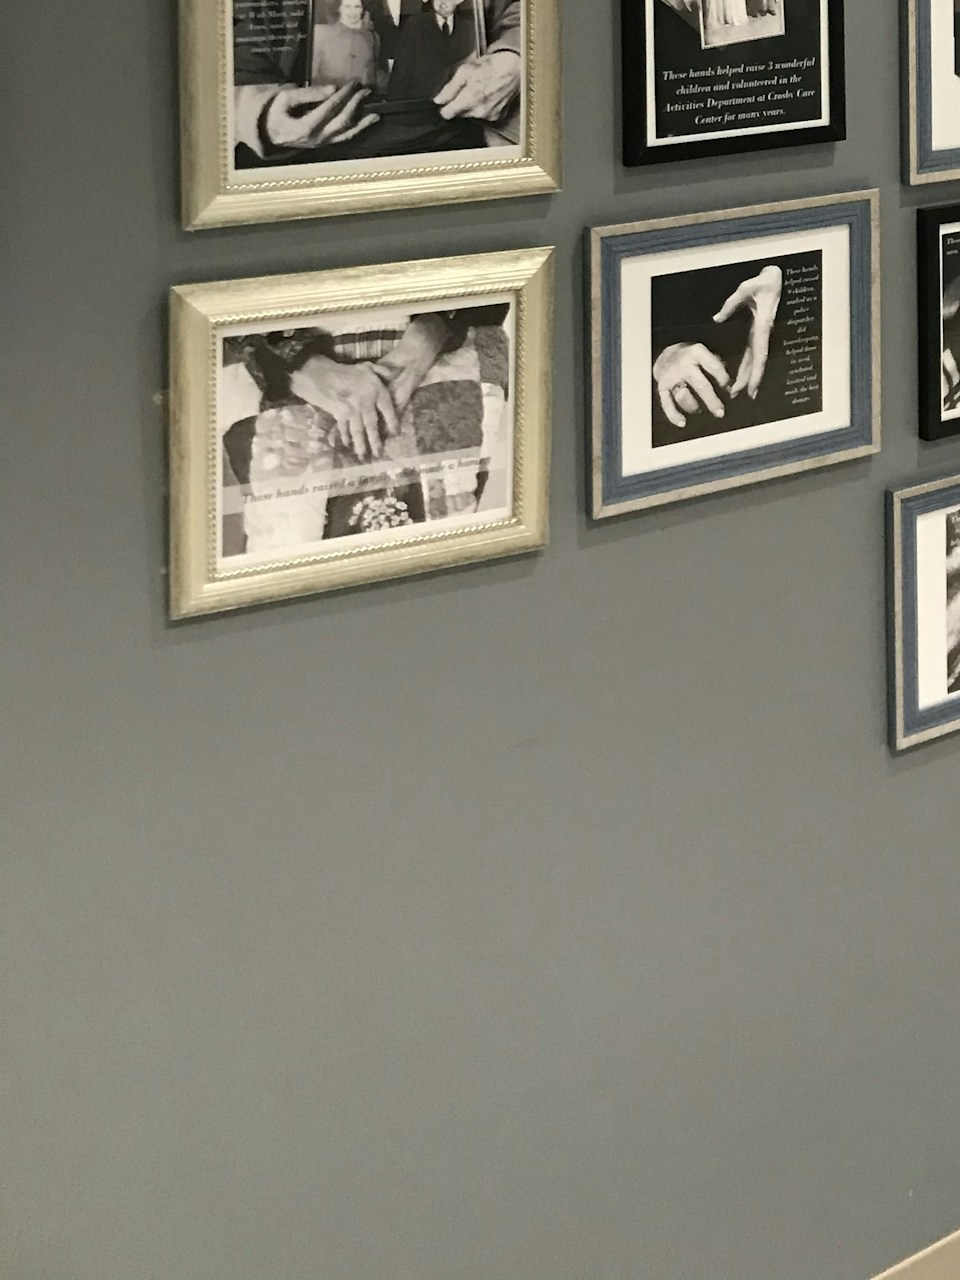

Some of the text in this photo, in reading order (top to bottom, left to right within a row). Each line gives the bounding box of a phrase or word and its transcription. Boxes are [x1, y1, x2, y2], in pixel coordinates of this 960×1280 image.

[662, 57, 816, 81] These hands helped raise 3 wonderful
[675, 74, 802, 96] children and volunteered in the
[663, 88, 816, 113] Activities Department at Crosby Care
[695, 113, 722, 125] Center
[722, 112, 736, 125] for
[738, 110, 761, 120] many
[276, 484, 309, 498] hands
